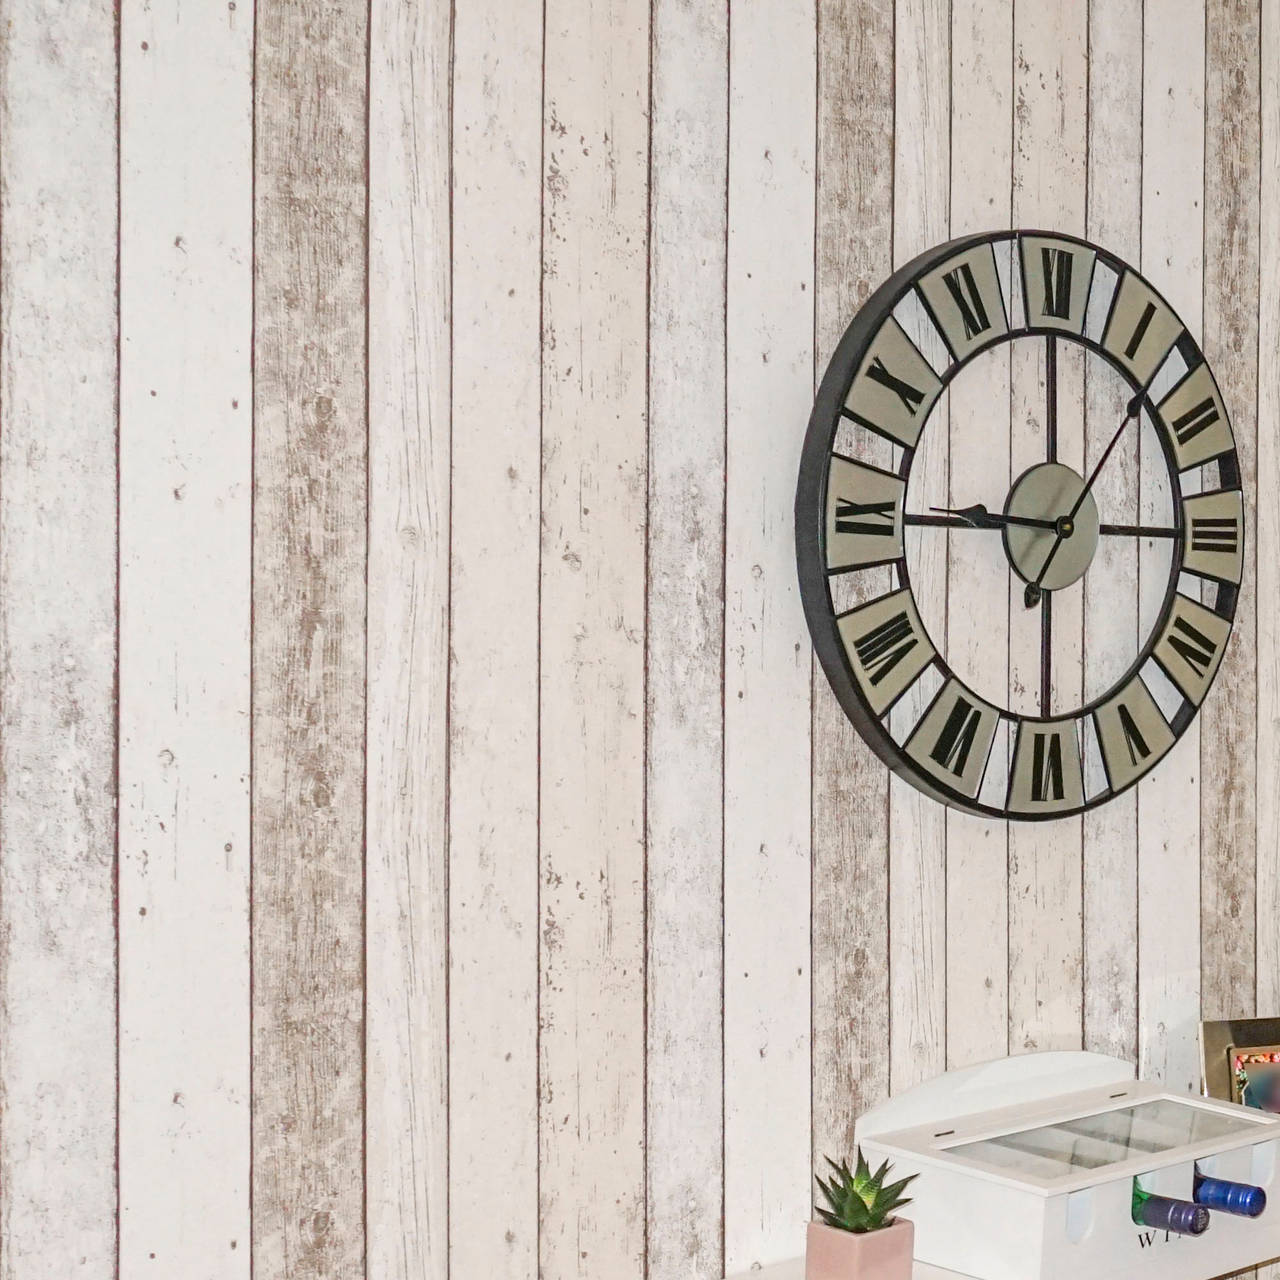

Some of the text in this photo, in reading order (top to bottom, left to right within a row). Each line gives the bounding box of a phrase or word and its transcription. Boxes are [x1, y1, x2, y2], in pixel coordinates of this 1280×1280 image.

[941, 262, 992, 341] XI
[1041, 247, 1074, 320] XII
[1124, 300, 1157, 361] I
[865, 355, 927, 419] X
[1172, 396, 1220, 446] II
[835, 496, 896, 537] IX
[1191, 517, 1238, 554] III
[853, 610, 919, 687] VIII
[1167, 615, 1217, 679] IV
[929, 696, 982, 778] VII
[1031, 732, 1065, 802] VI
[1117, 703, 1154, 767] V
